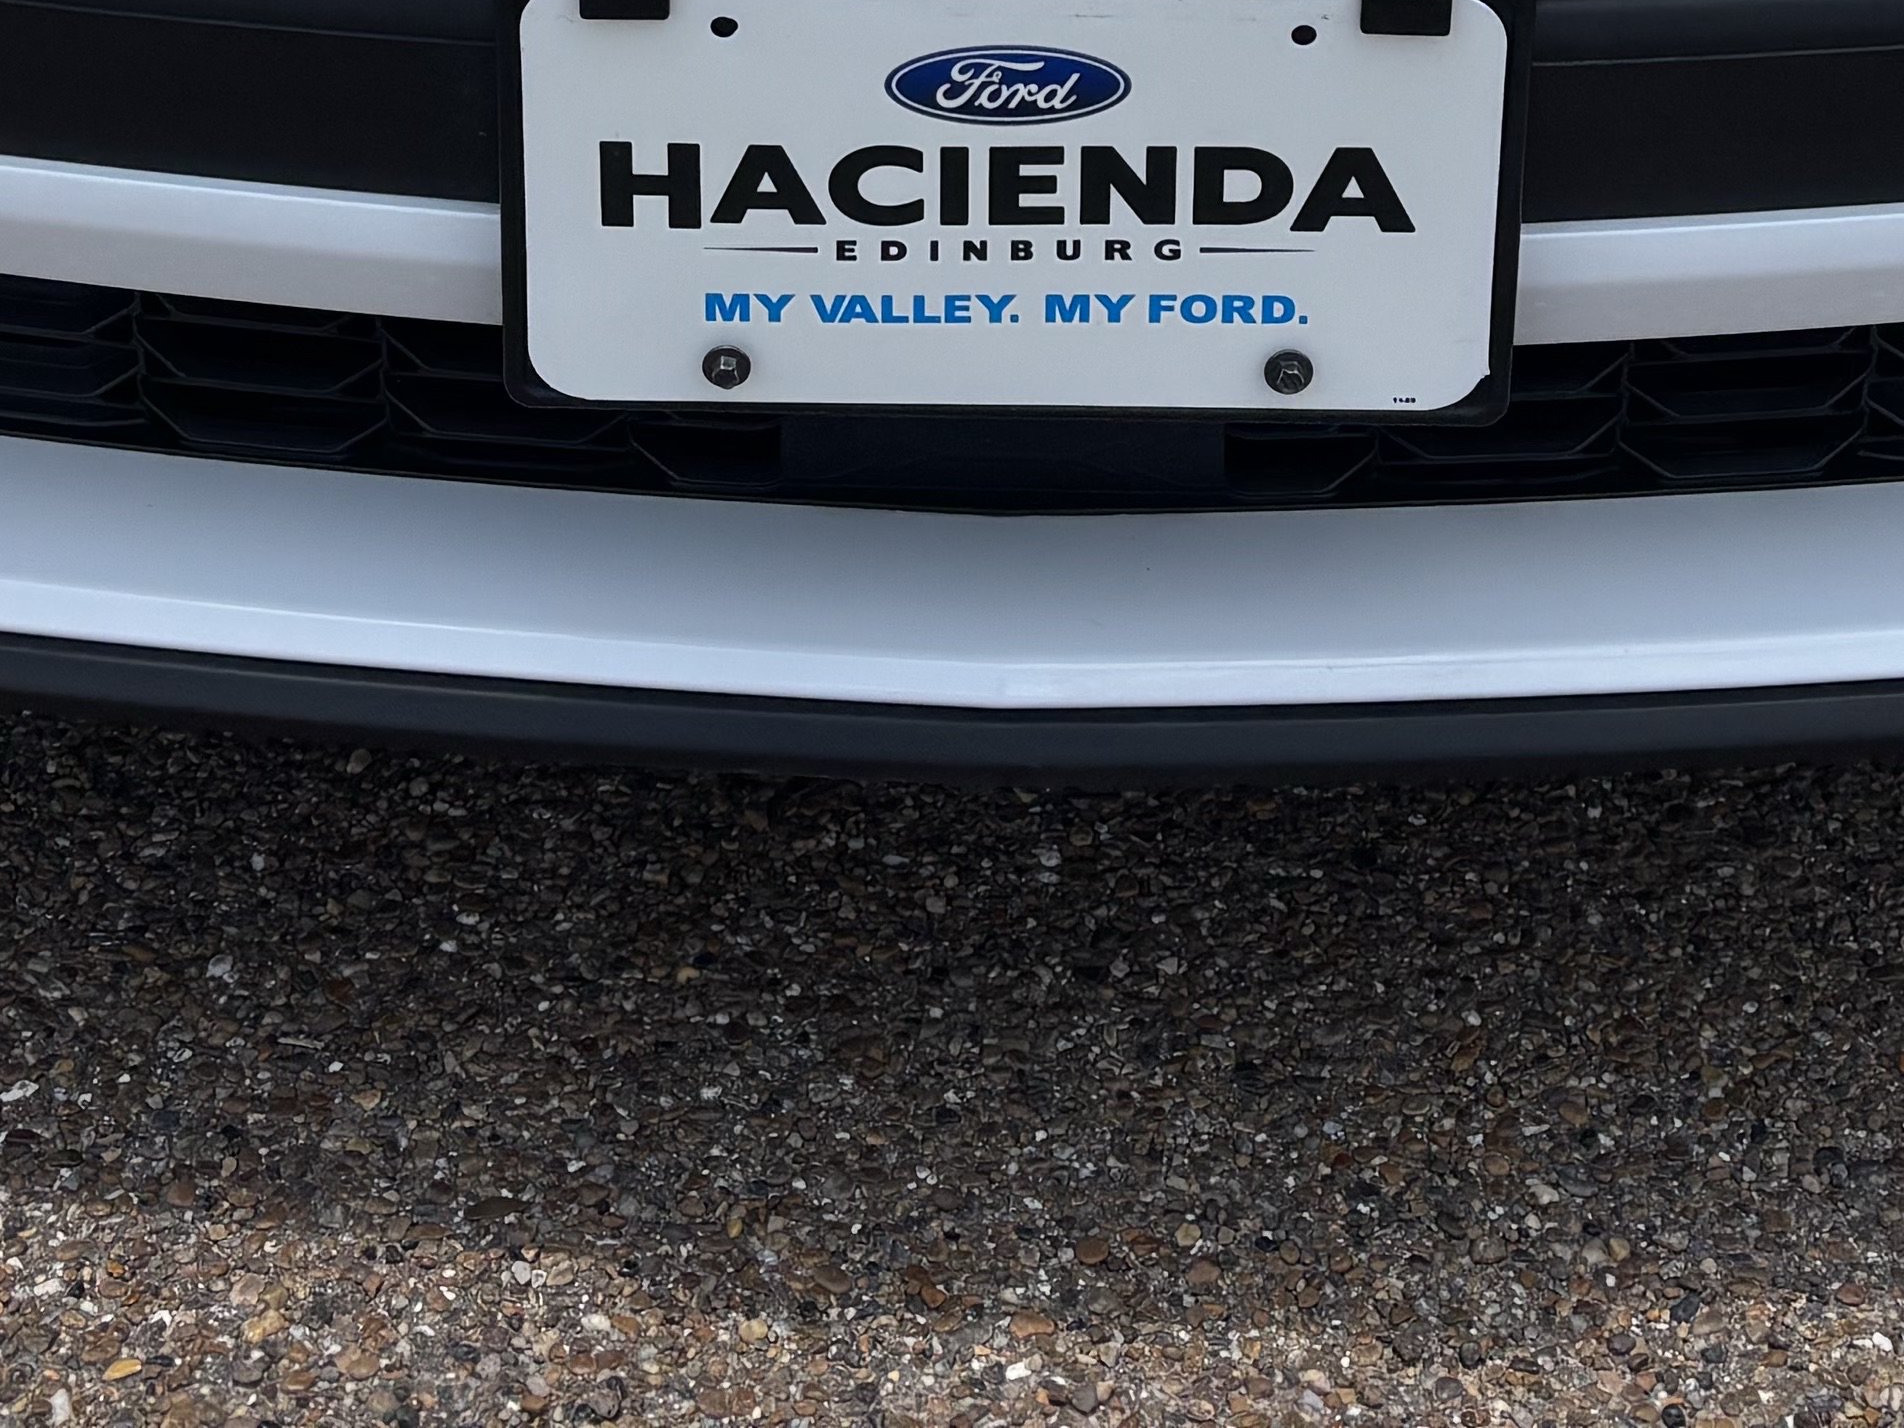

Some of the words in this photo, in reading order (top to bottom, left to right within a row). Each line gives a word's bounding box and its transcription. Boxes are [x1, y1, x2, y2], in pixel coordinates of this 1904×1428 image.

[935, 58, 1080, 110] Ford
[599, 140, 1416, 233] HACIENDA
[836, 238, 1182, 262] EDINBURG
[704, 292, 796, 323] MY
[810, 293, 1020, 324] VALLEY.
[1044, 293, 1135, 324] MY
[1148, 294, 1309, 325] FORD.
